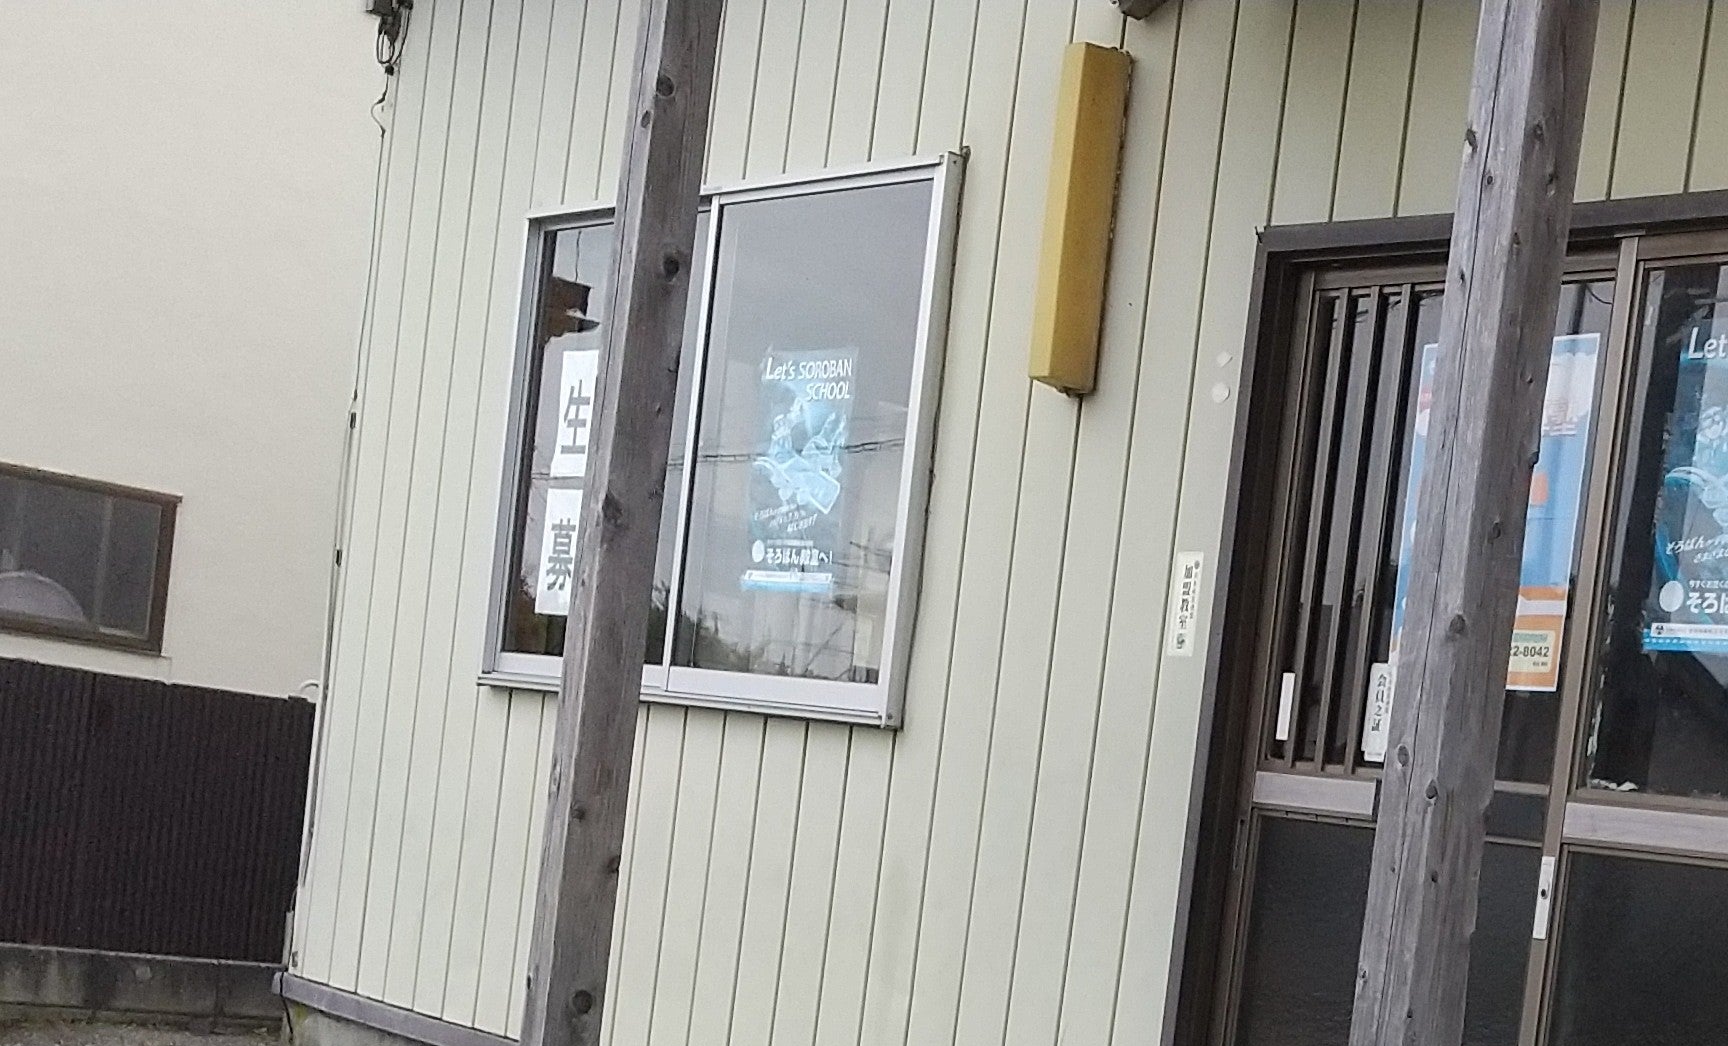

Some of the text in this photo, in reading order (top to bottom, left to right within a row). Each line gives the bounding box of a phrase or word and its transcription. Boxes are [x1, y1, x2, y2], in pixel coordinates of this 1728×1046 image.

[765, 357, 852, 381] Let's SOROBAN
[806, 381, 850, 400] SCHOOL
